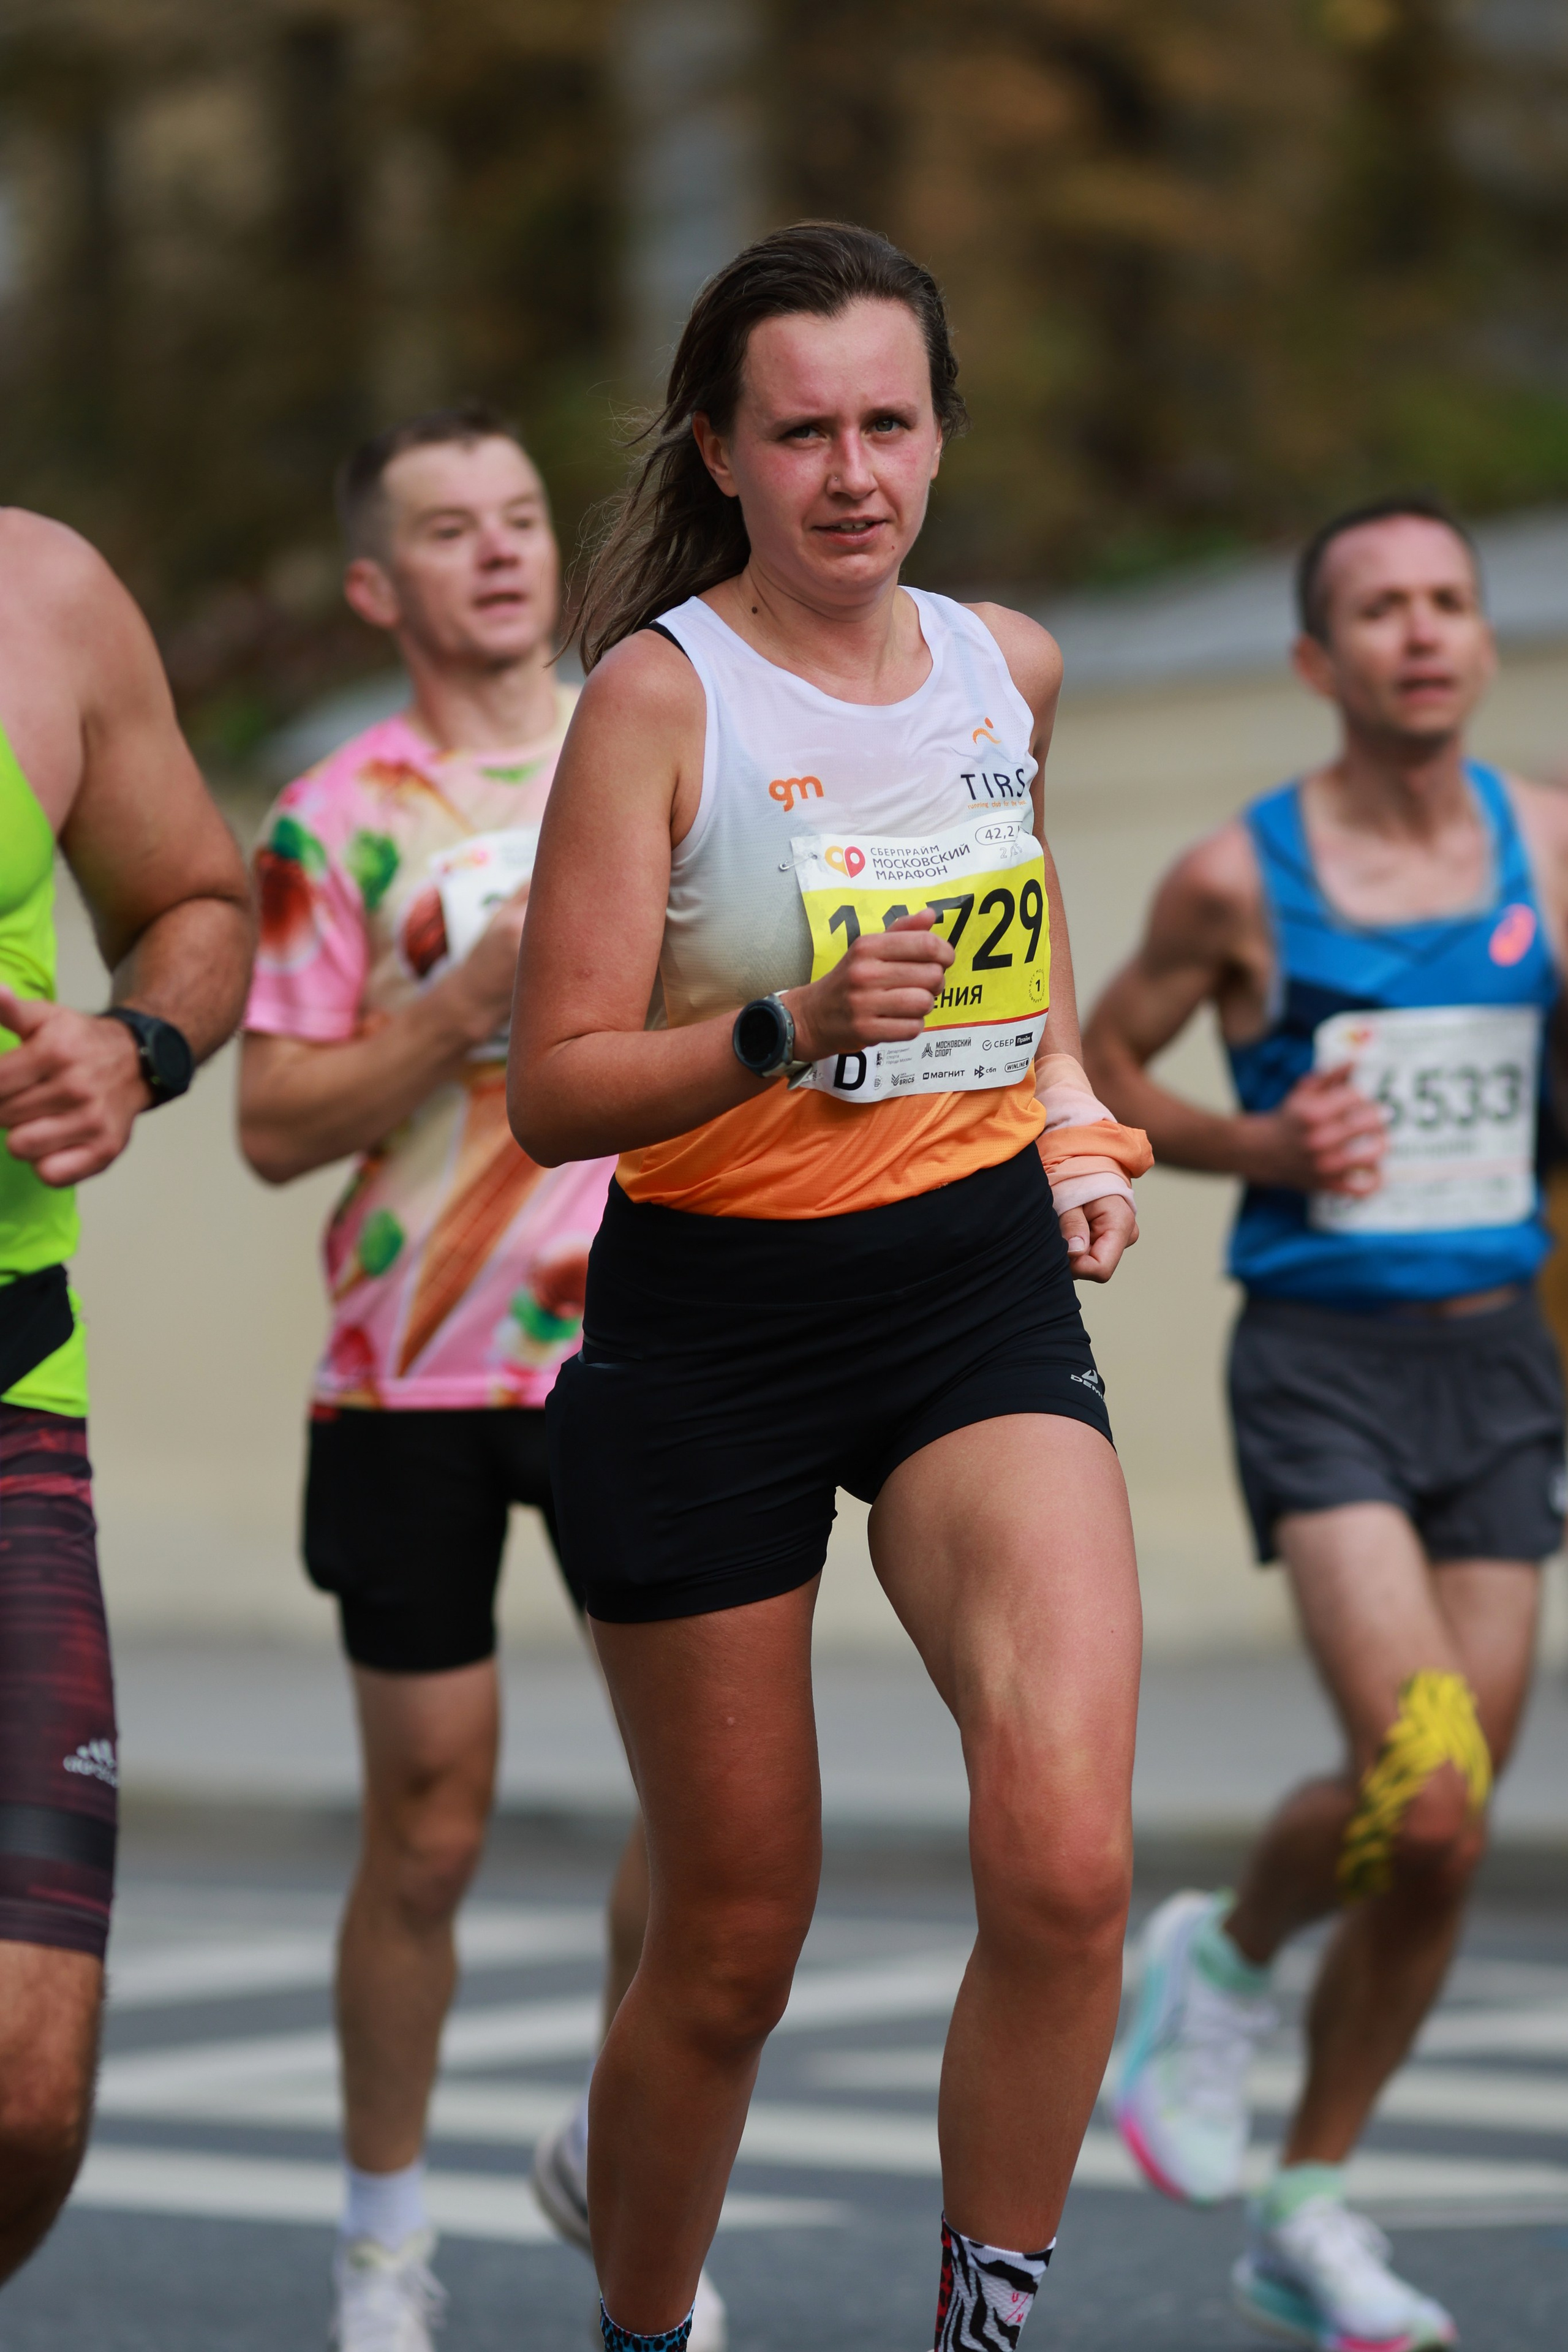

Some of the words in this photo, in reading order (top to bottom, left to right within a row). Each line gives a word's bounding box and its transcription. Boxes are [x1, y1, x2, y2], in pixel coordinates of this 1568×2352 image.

[960, 768, 1025, 800] TIRS
[985, 826, 1014, 840] 42,2
[870, 845, 940, 856] СБЕРПРАЙМ
[872, 843, 971, 869] МОСКОВСКИЙ
[876, 865, 948, 881] МАРАФОН
[1035, 979, 1041, 992] 1
[935, 1036, 971, 1049] МОСКОВСКИЙ
[994, 1039, 1014, 1048] СБЕР
[935, 1049, 952, 1057] СПОРТ
[834, 1050, 867, 1091] D
[1007, 1061, 1026, 1071] WINLINE
[899, 1077, 915, 1085] BRICS
[930, 1070, 965, 1079] магнит
[1070, 1374, 1105, 1402] DEMI
